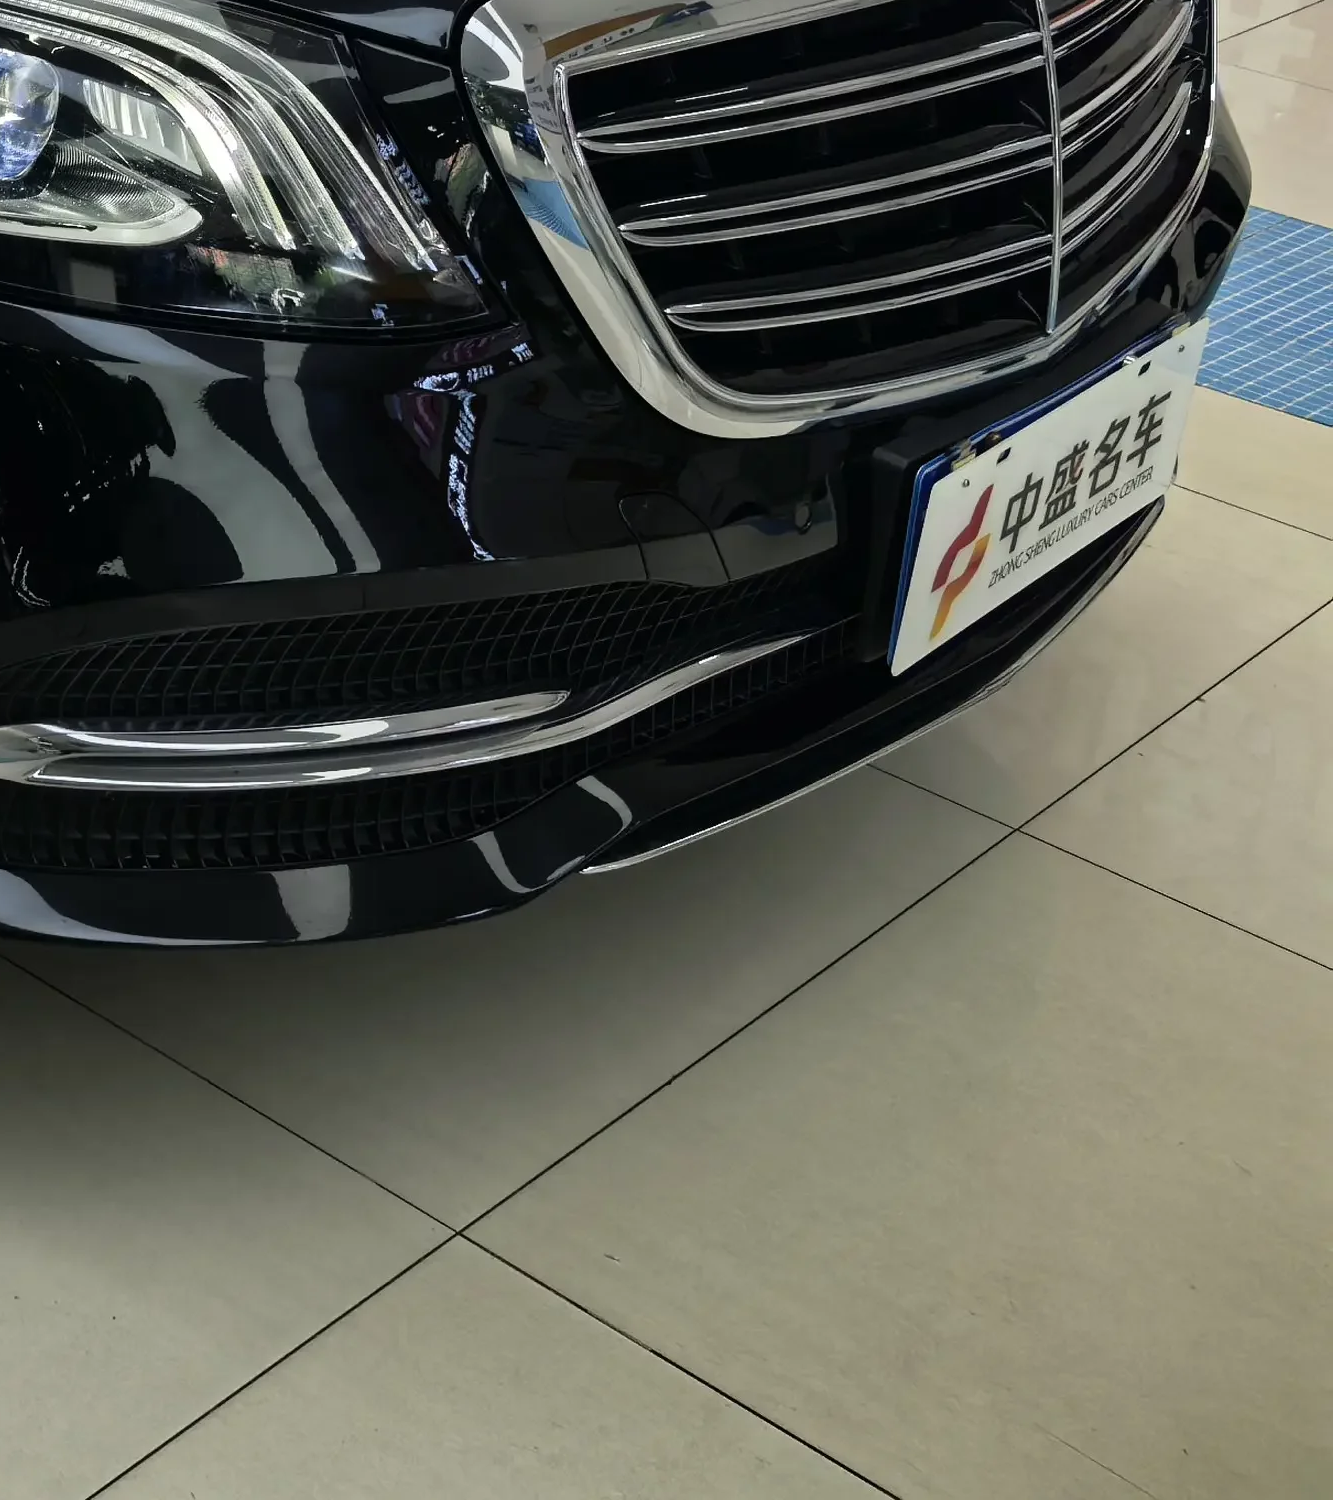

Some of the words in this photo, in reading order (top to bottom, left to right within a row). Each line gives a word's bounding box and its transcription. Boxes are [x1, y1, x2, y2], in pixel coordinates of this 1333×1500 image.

[988, 551, 1024, 589] ZHONG
[1094, 488, 1120, 516] CARS
[1118, 466, 1154, 500] CENTER
[1000, 391, 1172, 553] 中盛名车
